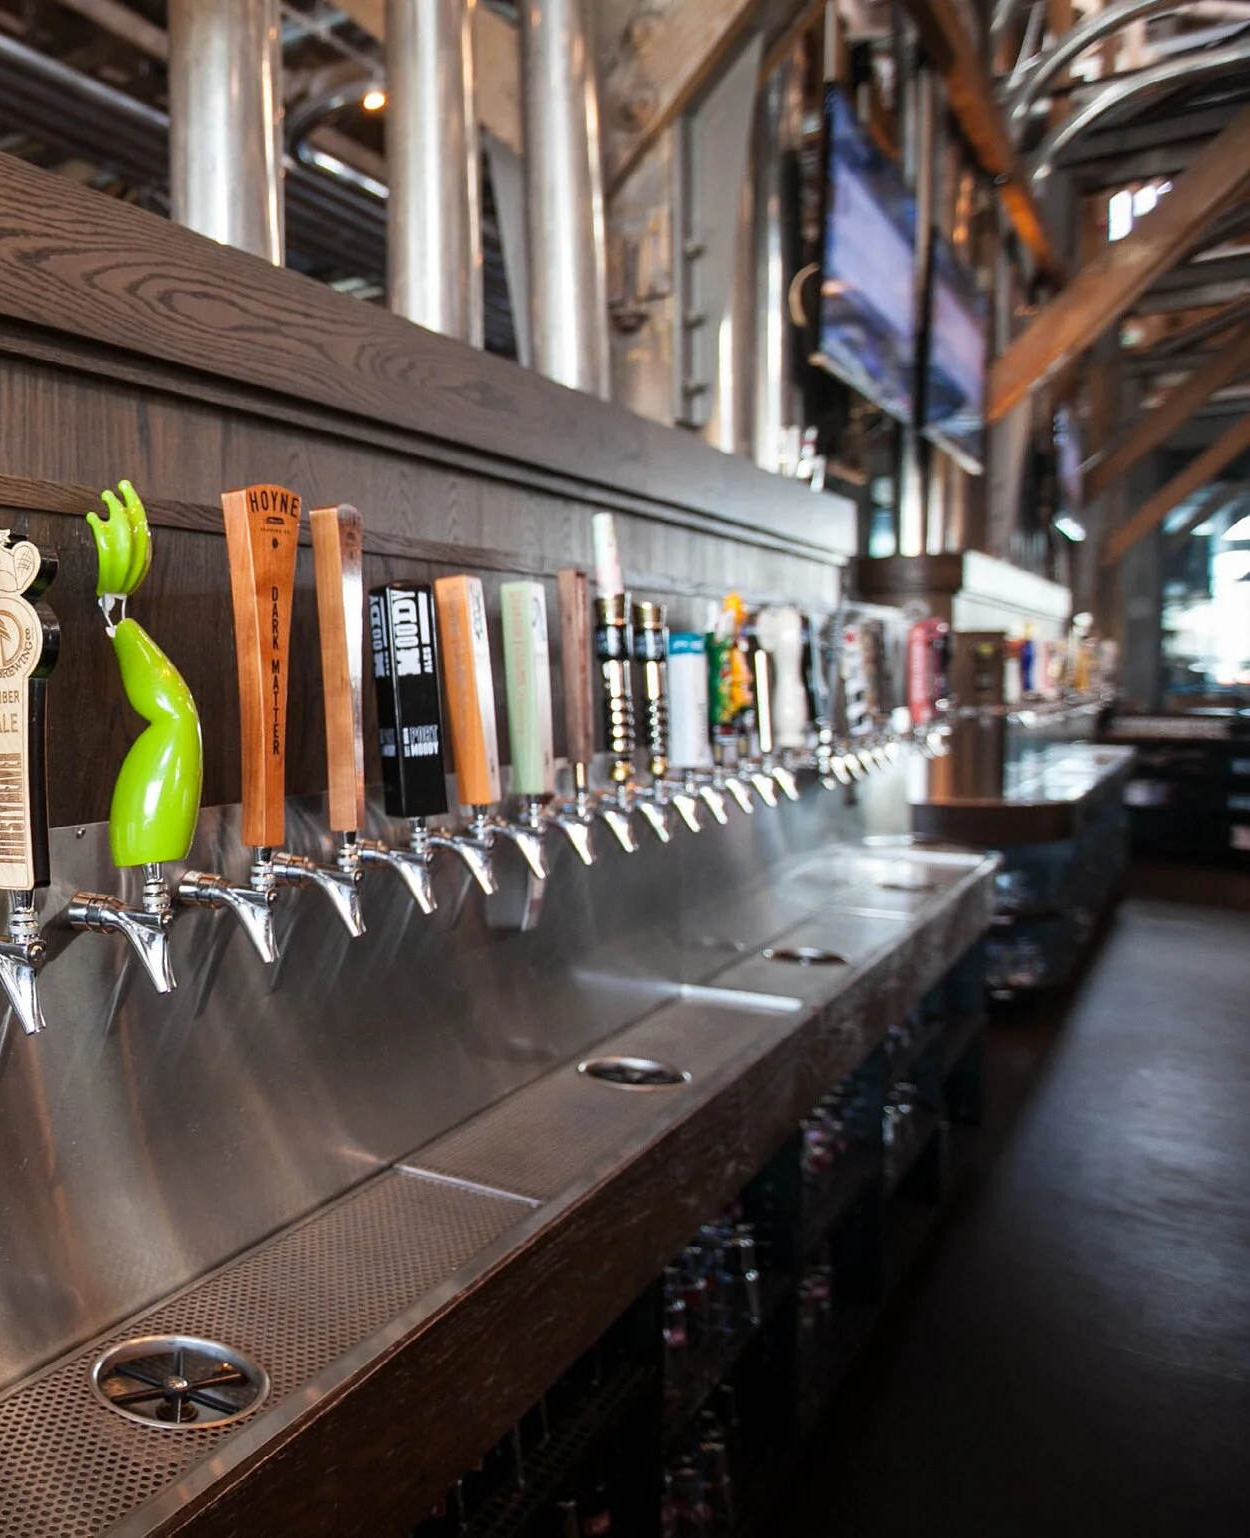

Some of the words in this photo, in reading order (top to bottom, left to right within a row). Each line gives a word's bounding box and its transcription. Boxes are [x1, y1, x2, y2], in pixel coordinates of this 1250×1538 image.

[249, 490, 299, 518] HOYNE
[271, 586, 279, 649] DARK
[390, 588, 422, 677] MOODY
[271, 659, 280, 755] MATTER
